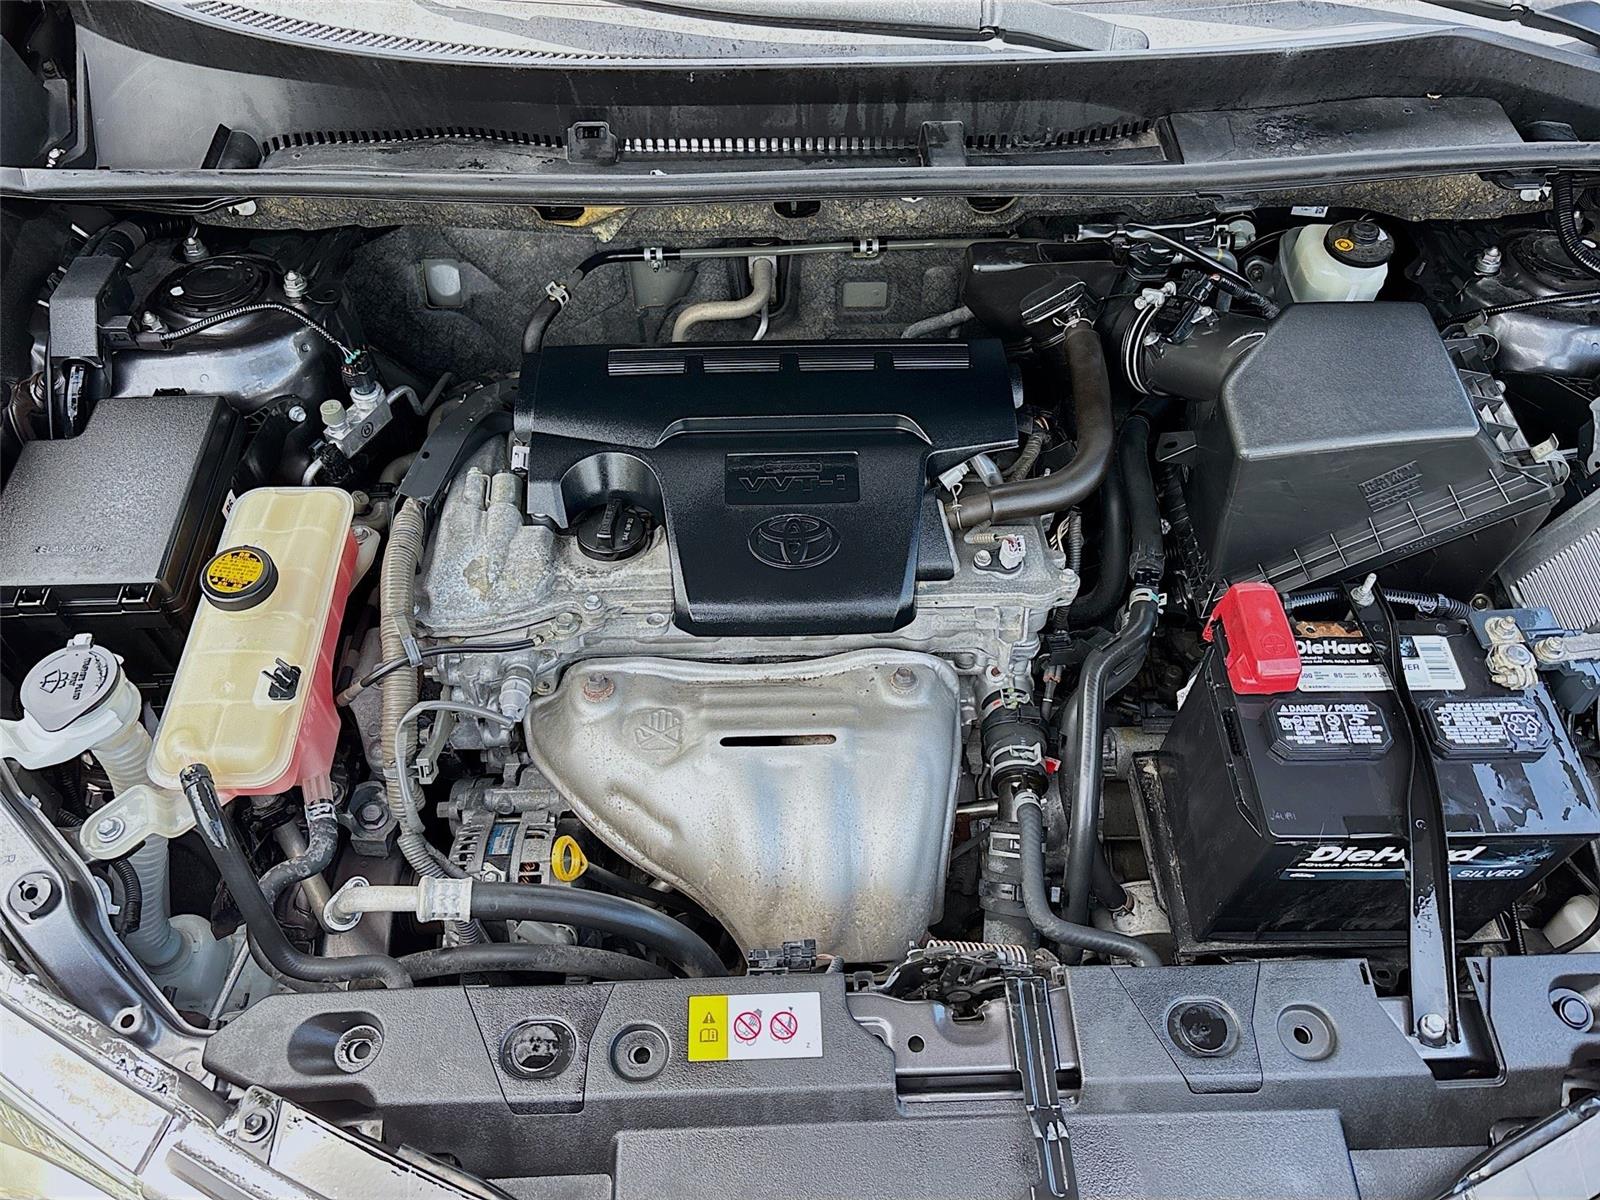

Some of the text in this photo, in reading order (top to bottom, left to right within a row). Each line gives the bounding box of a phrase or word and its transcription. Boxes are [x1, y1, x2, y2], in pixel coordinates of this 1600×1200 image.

[1288, 704, 1326, 712] DANGER
[1334, 703, 1369, 712] POISON
[1456, 869, 1524, 878] SILVER
